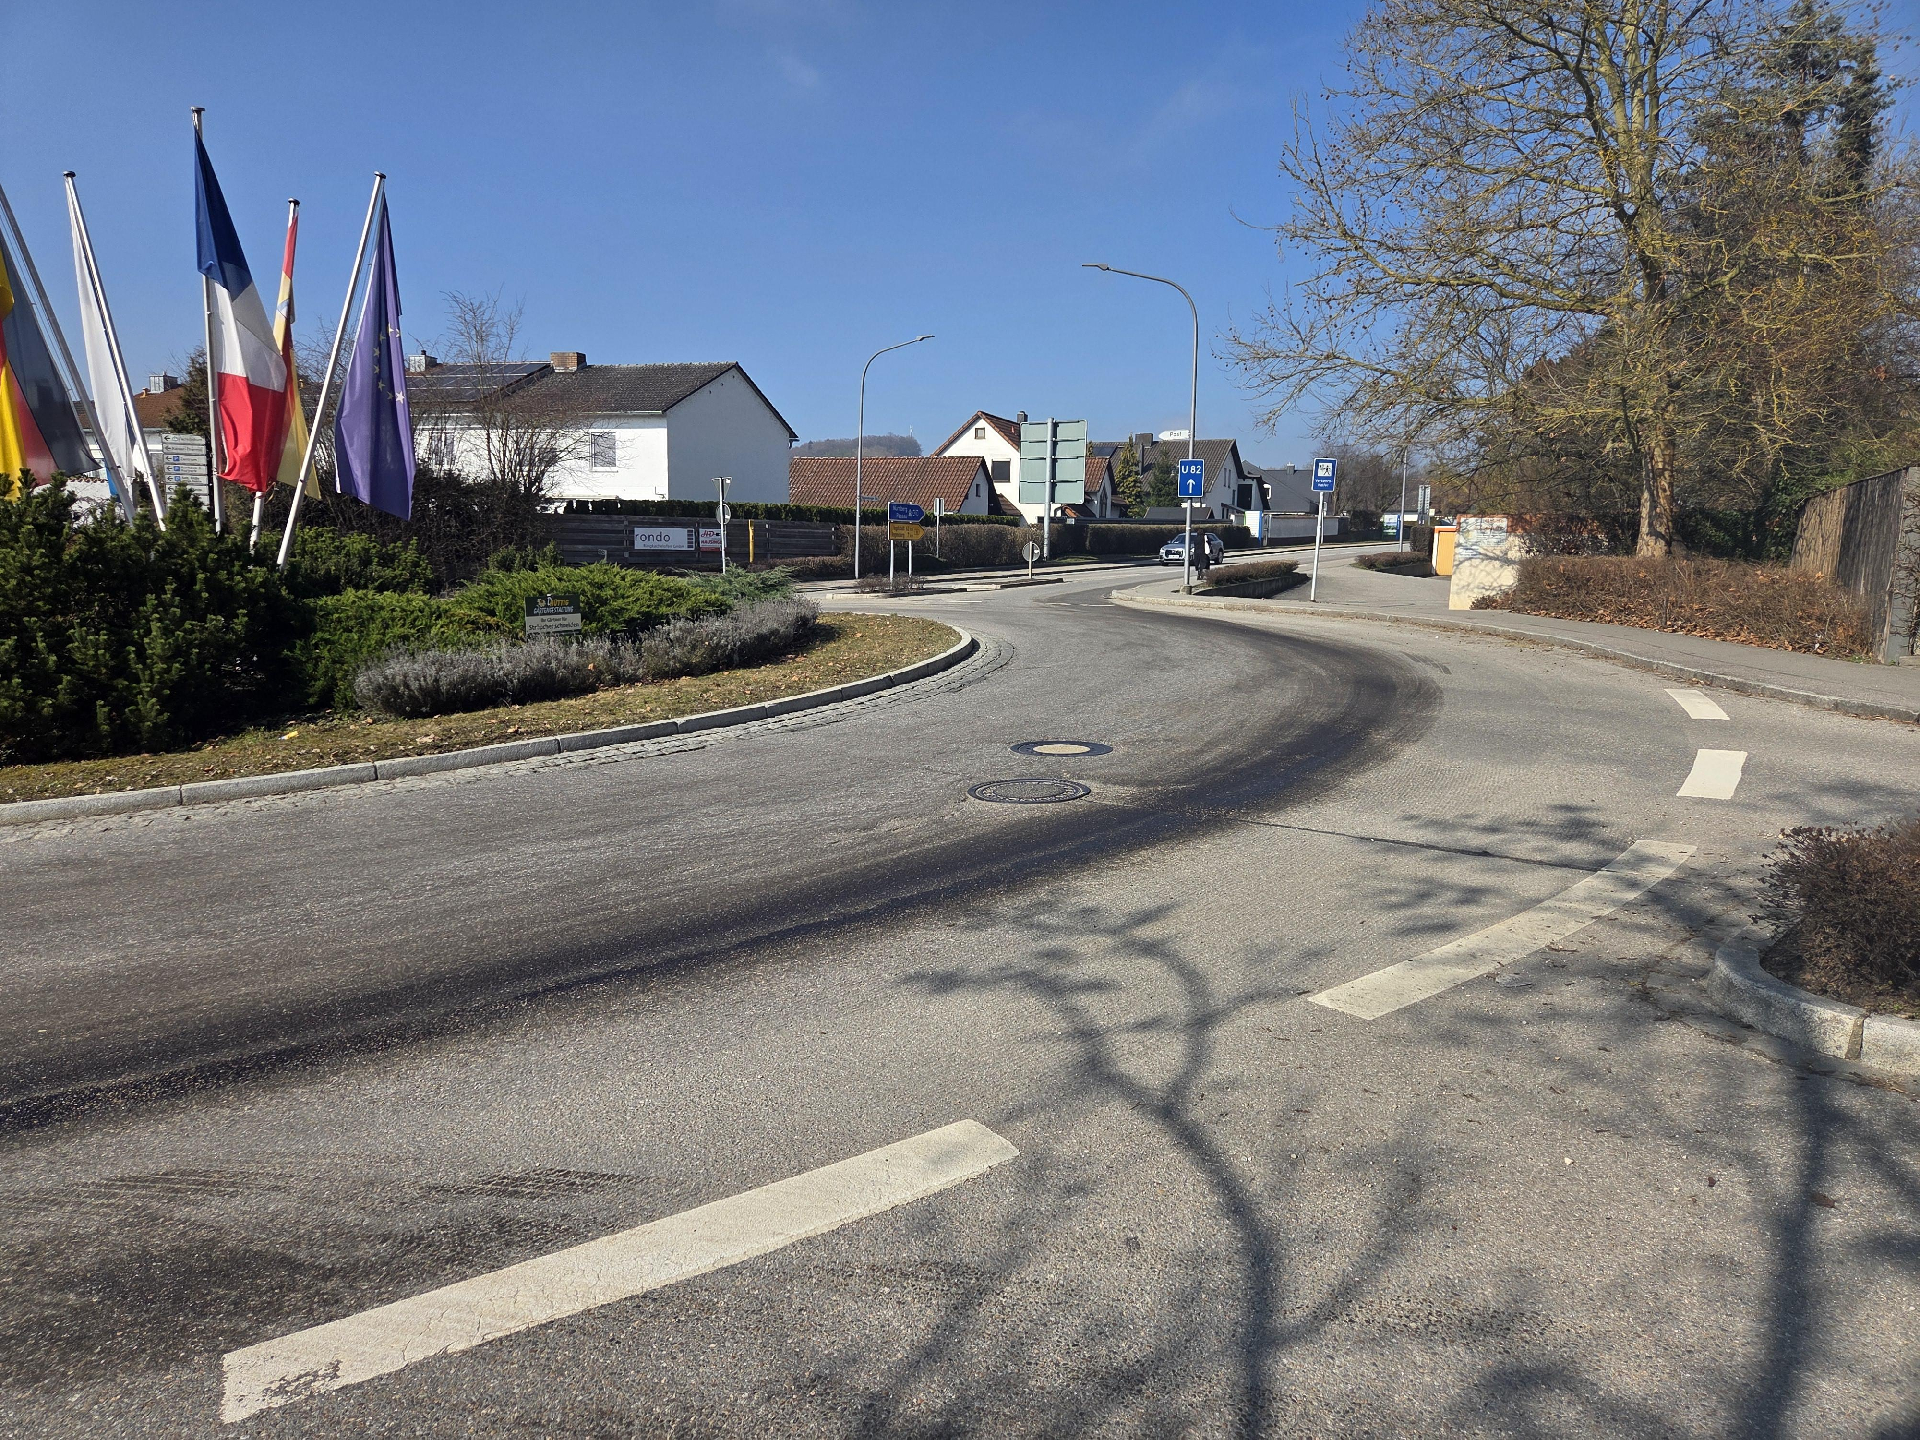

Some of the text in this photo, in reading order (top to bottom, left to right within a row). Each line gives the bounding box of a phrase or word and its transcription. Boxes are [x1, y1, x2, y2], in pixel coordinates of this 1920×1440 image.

[1181, 465, 1202, 474] U 82
[635, 531, 671, 542] rondo
